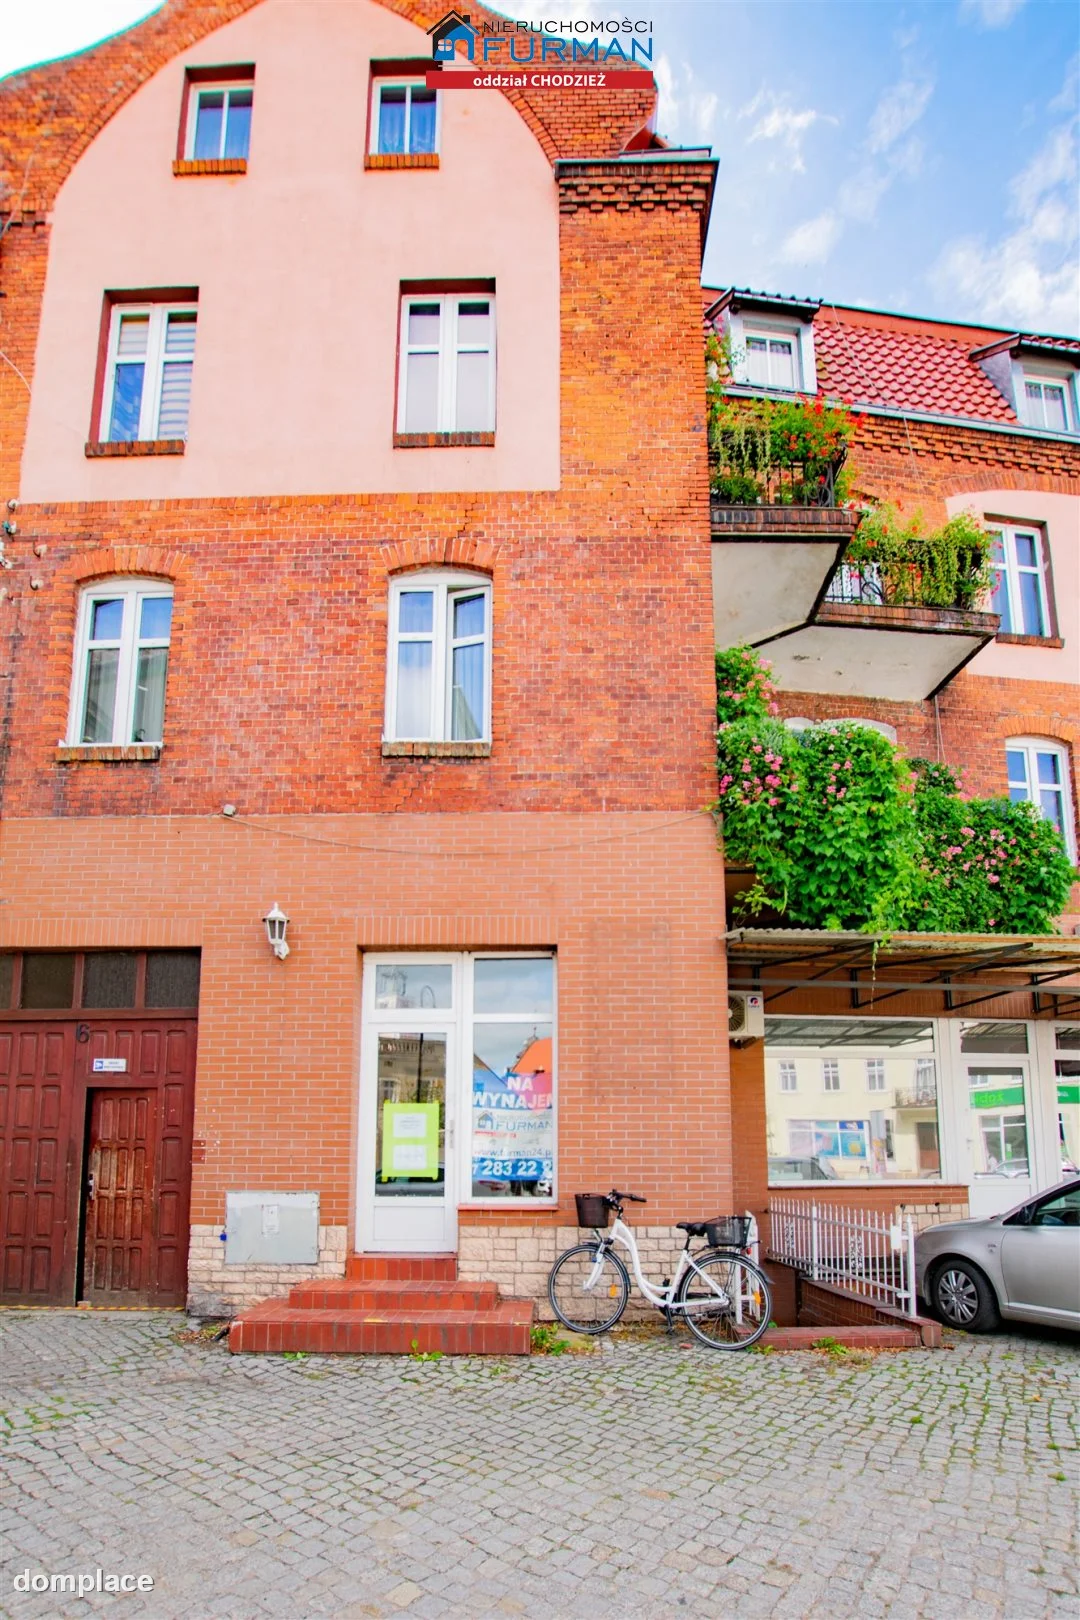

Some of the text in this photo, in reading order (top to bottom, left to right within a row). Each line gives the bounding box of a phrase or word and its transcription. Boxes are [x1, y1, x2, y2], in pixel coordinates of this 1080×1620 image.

[76, 1023, 90, 1043] 6
[507, 1077, 533, 1091] NA
[482, 1160, 512, 1176] 283
[516, 1161, 538, 1176] 22
